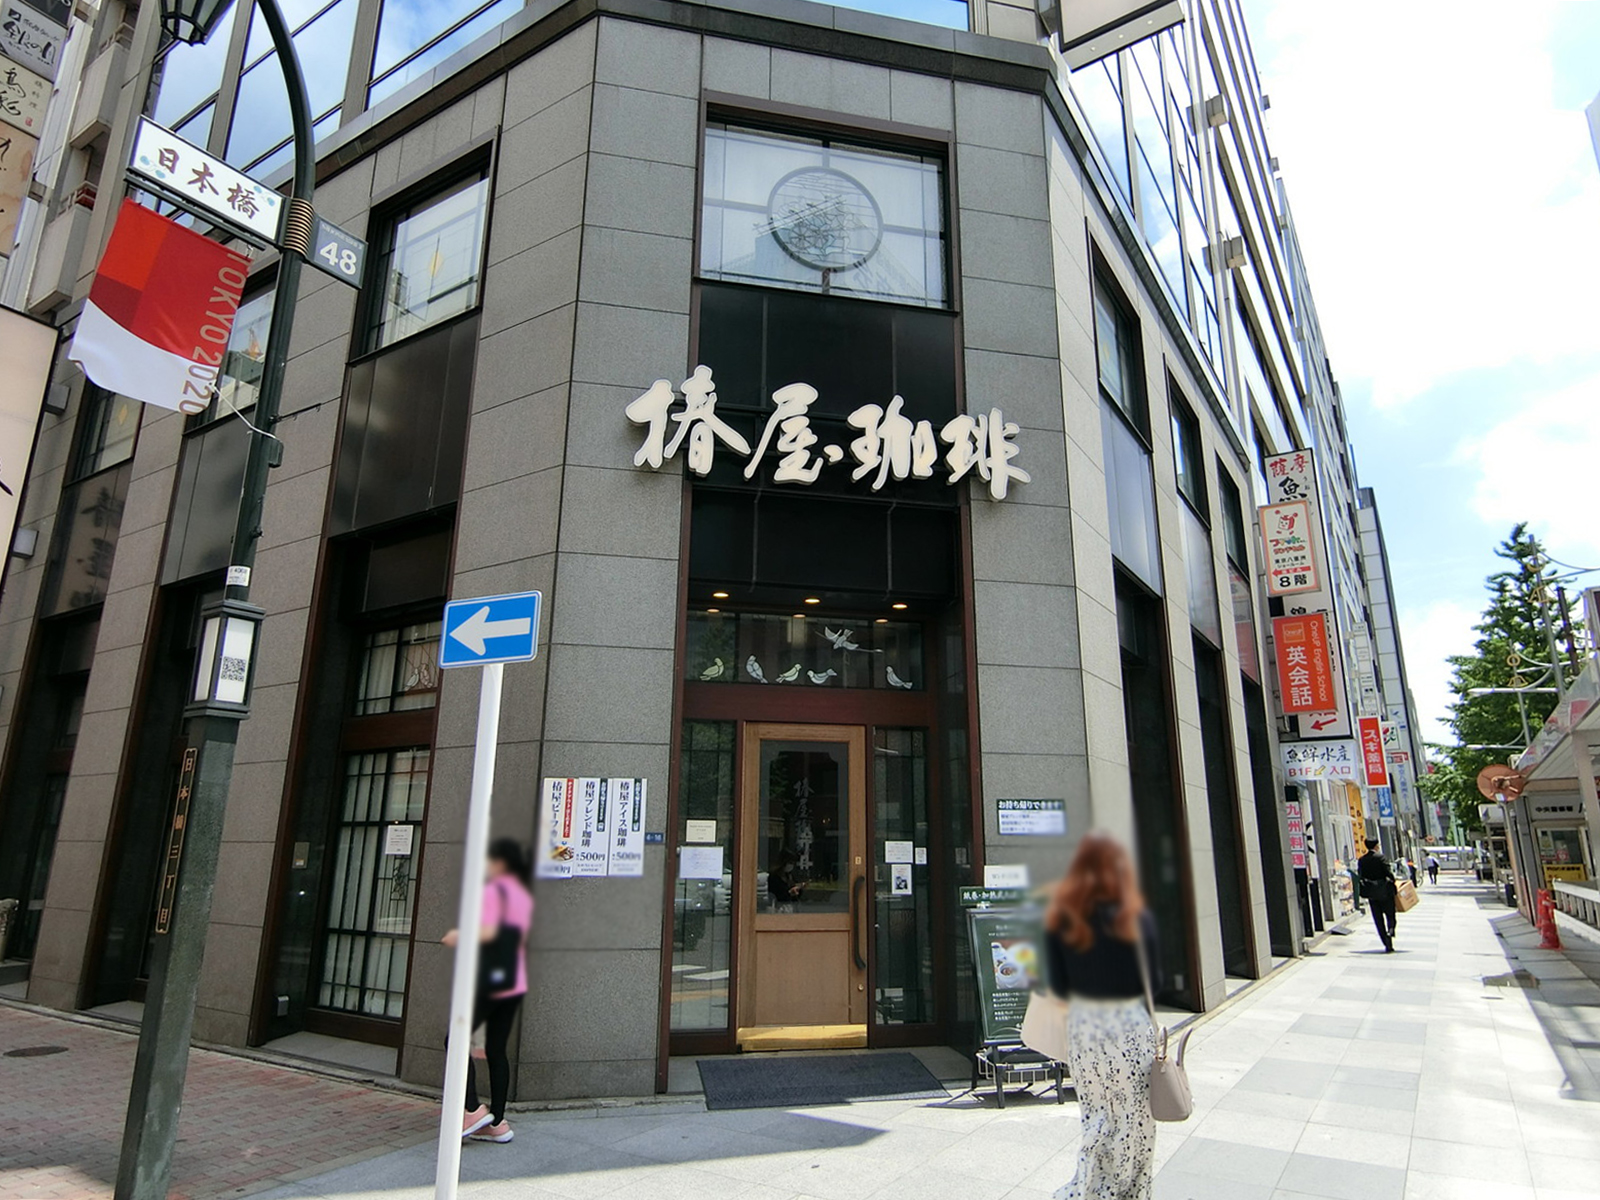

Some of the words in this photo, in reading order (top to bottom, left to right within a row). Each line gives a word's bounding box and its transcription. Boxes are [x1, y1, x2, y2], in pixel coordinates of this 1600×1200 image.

[158, 147, 260, 219] 日本橋
[320, 241, 357, 275] 48
[200, 253, 254, 345] TOKYO
[179, 346, 223, 416] 2020
[625, 364, 1032, 500] 椿屋珈琲
[1269, 453, 1309, 477] 薩摩
[1280, 575, 1307, 587] 8階
[1286, 645, 1313, 706] 英会話
[1286, 745, 1351, 764] 魚鮮水産
[1288, 766, 1311, 777] B1F
[1329, 765, 1351, 776] 入口
[581, 781, 596, 848] 椿屋ブレンド珈琲
[617, 781, 630, 848] 椿屋アイス珈琲
[1285, 803, 1305, 866] 九州料理
